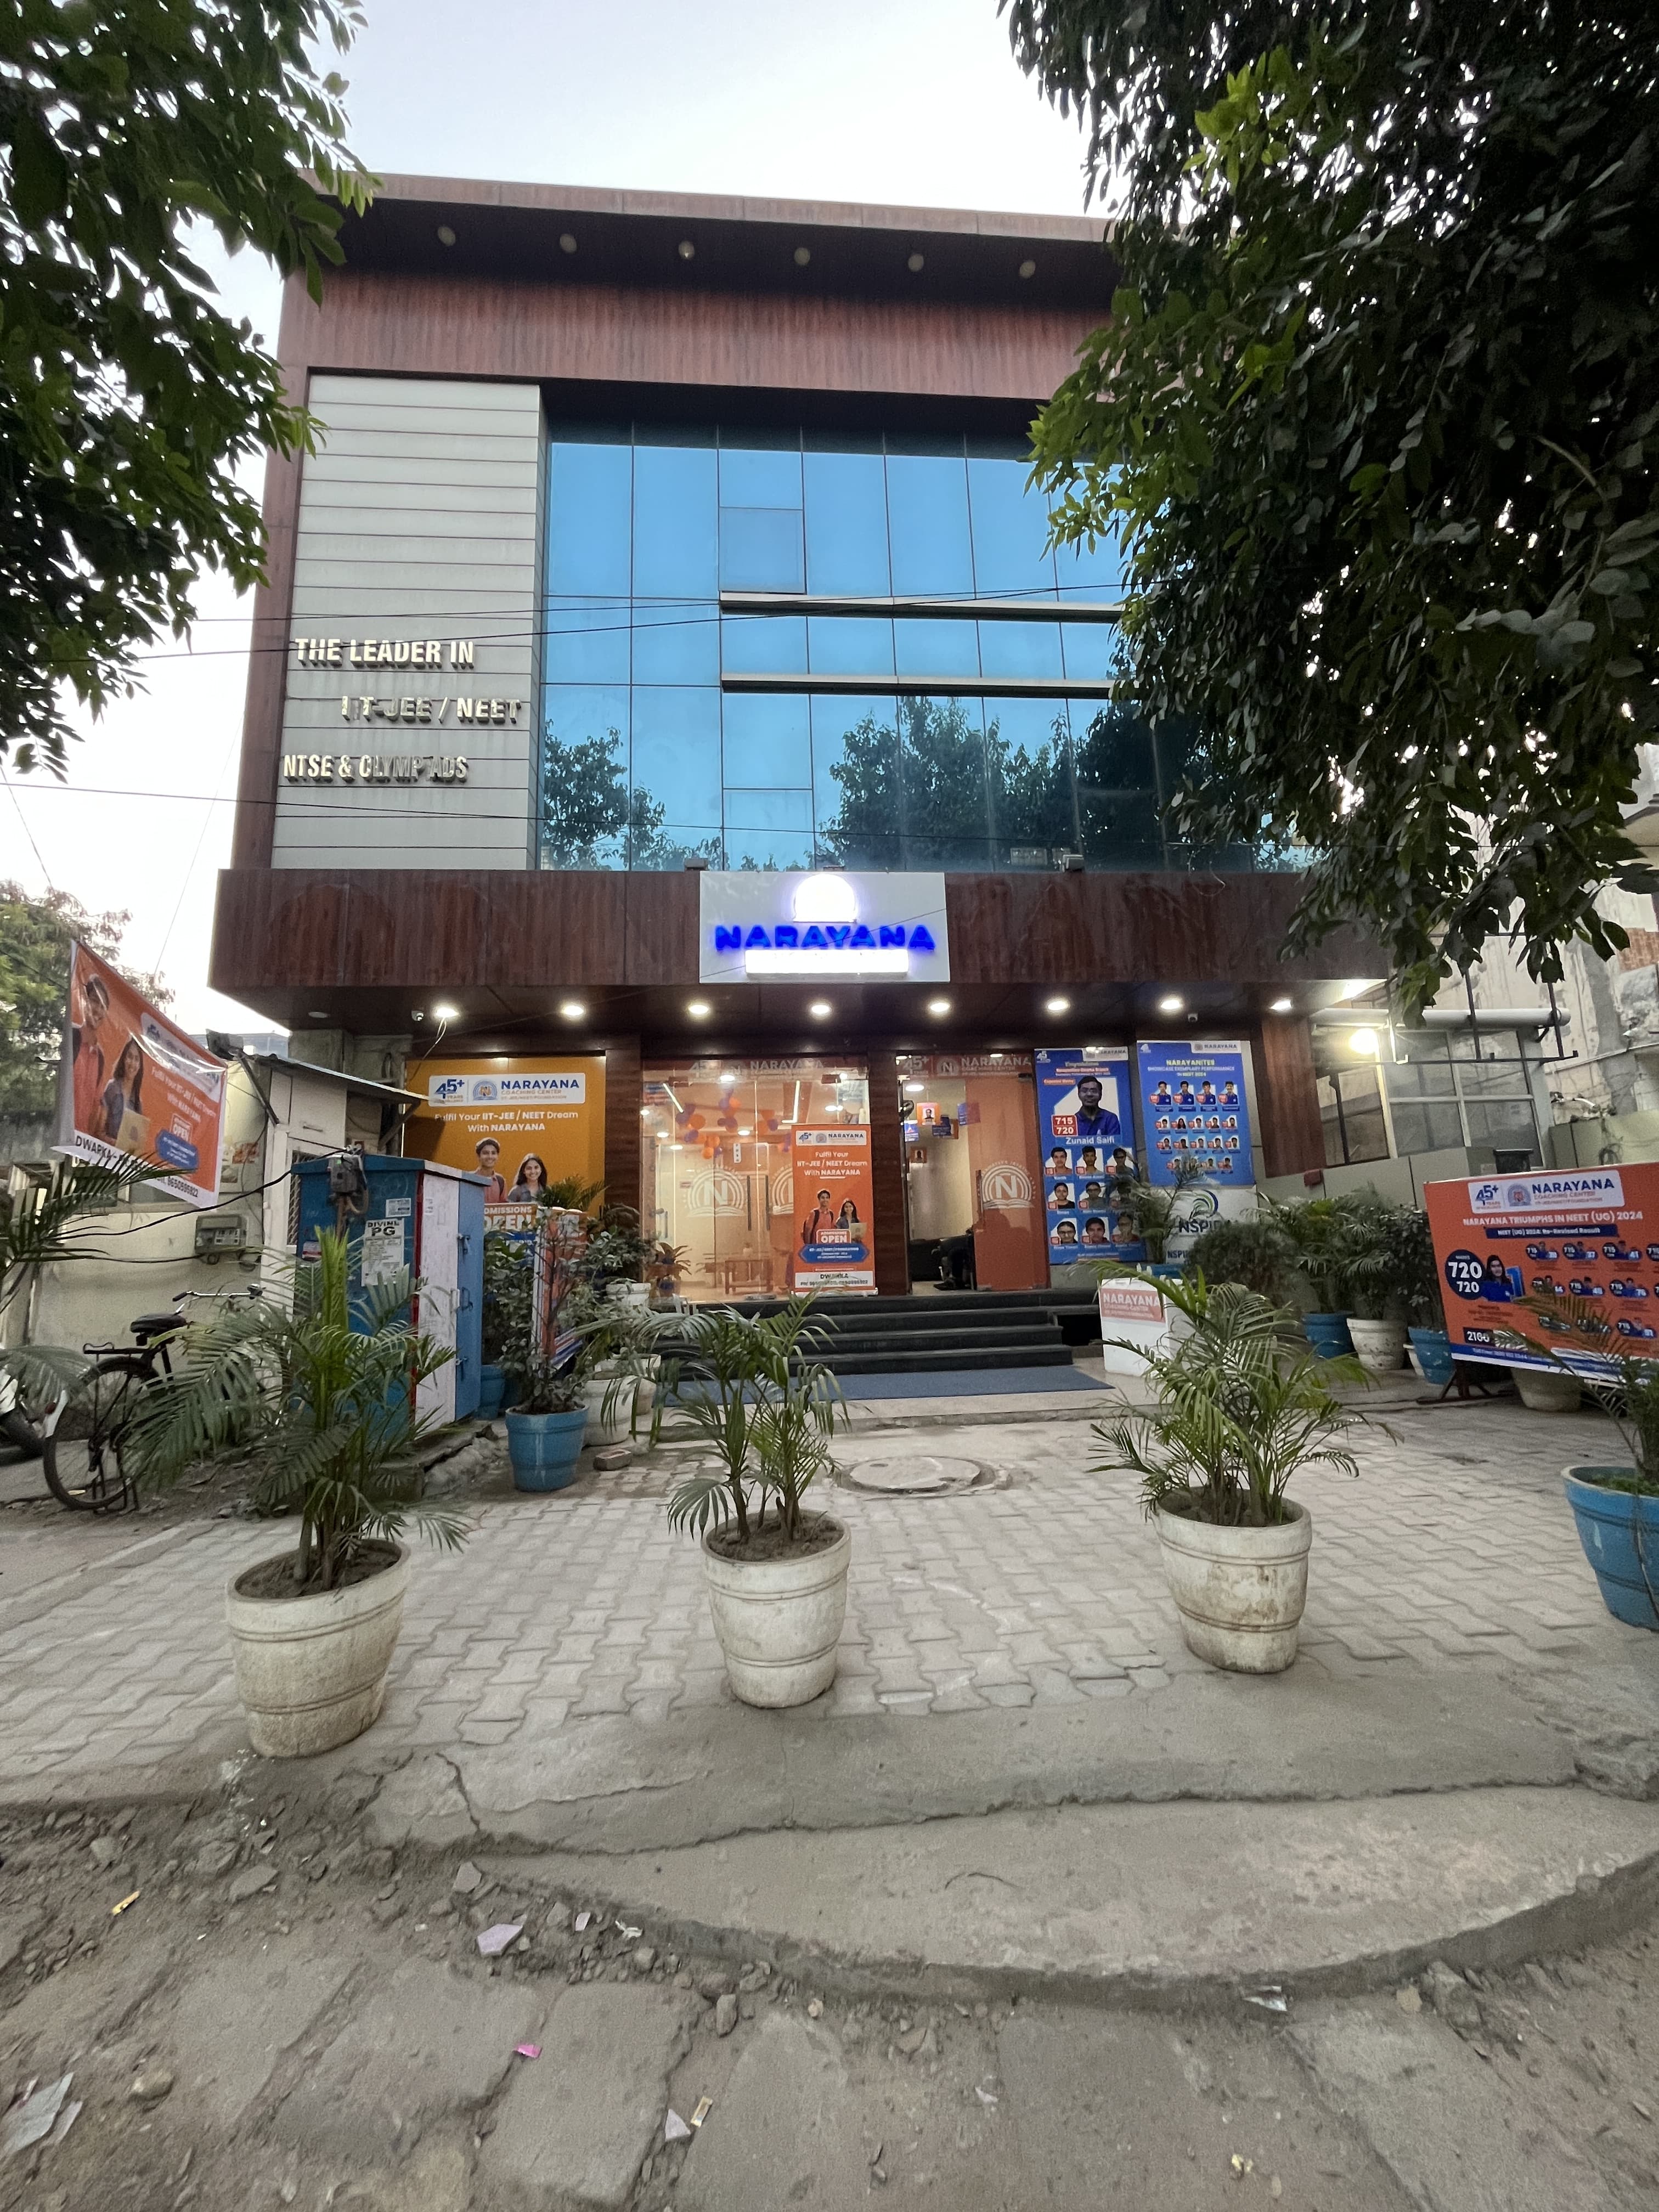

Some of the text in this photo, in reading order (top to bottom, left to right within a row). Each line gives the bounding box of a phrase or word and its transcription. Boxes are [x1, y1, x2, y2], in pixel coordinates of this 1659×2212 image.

[295, 638, 475, 665] THE LEADER IN
[438, 697, 448, 723] /
[456, 698, 522, 720] NEET
[284, 754, 468, 781] NTSE & OLYMPADS
[715, 924, 935, 951] NARAYANA
[750, 1059, 823, 1071] NARAYAA
[961, 1057, 1031, 1066] NARAYANA
[435, 1079, 465, 1099] 45+
[501, 1080, 579, 1090] NARAYANA
[467, 1123, 545, 1132] With NARAYANA
[704, 1180, 728, 1206] N
[995, 1175, 1017, 1199] N
[1532, 1178, 1614, 1194] NARAYANA
[1476, 1185, 1498, 1205] 45+
[1463, 1211, 1643, 1226] NARAYANA TRIUMPHS IN NEET (UG) 2024
[371, 1226, 396, 1237] PG
[1448, 1262, 1482, 1279] 720
[1457, 1281, 1480, 1293] 720
[1103, 1293, 1160, 1306] NARAYANA
